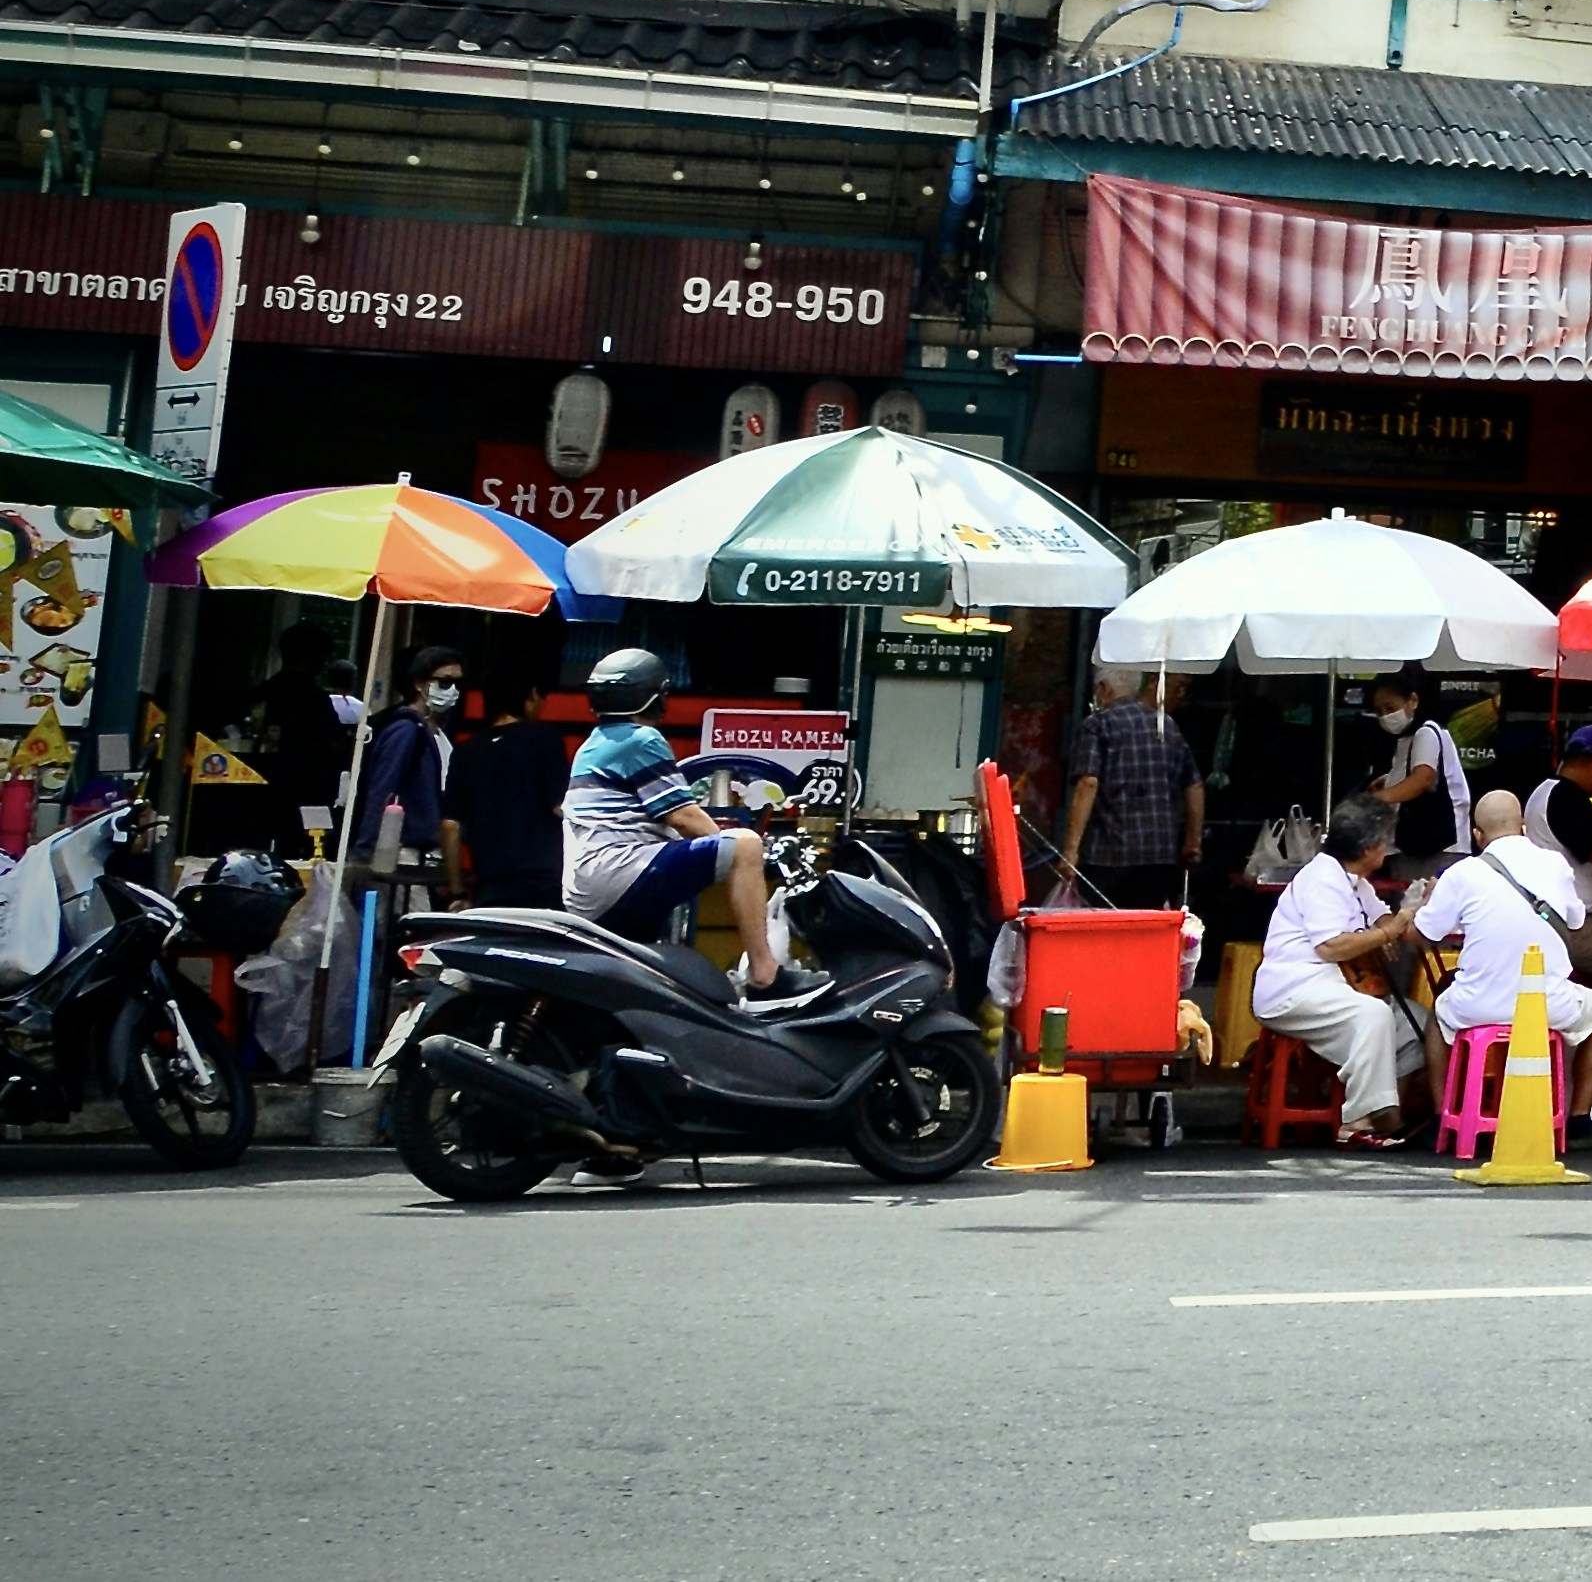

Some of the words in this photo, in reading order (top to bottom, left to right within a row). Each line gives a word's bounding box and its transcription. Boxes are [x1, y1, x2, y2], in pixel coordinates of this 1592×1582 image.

[682, 276, 885, 326] 948-950
[1321, 315, 1400, 341] FENG
[1107, 451, 1138, 468] 946
[481, 478, 638, 521] SHOZU
[765, 569, 921, 593] 0-2118-7911
[713, 729, 772, 743] SHOZU
[782, 729, 844, 744] RAMEN
[1459, 748, 1497, 759] TCHA
[811, 766, 843, 778] ราคา
